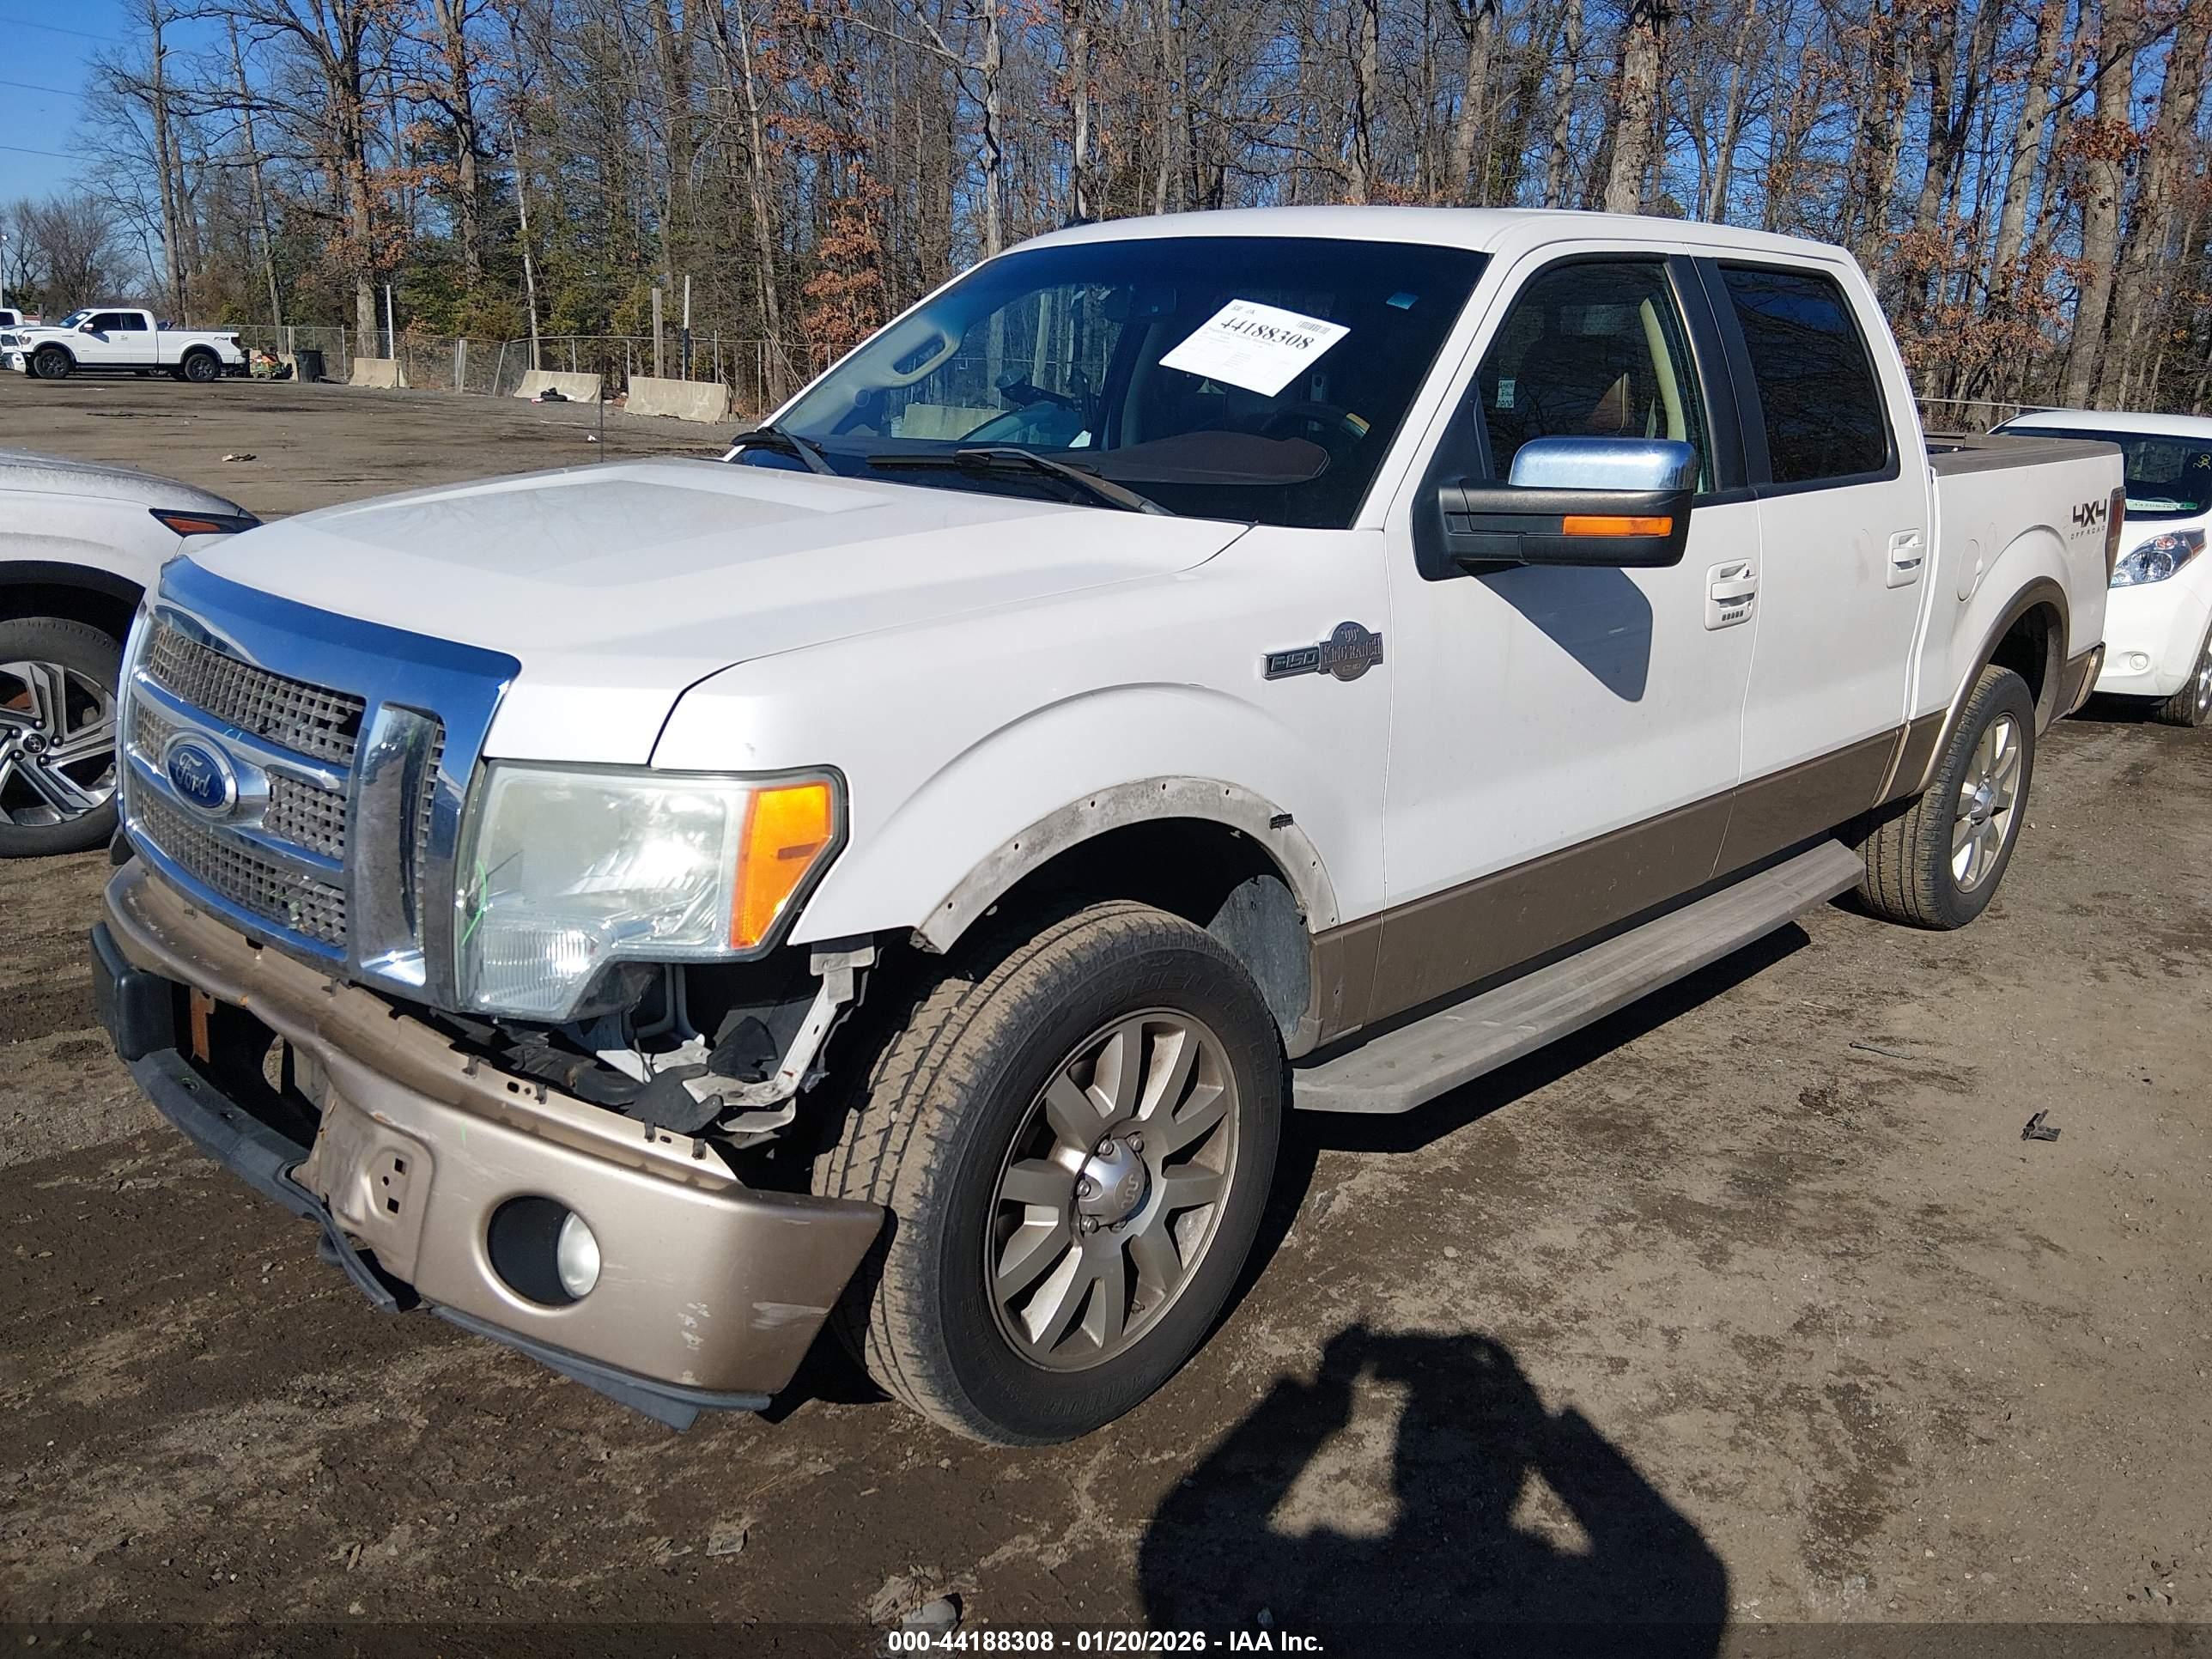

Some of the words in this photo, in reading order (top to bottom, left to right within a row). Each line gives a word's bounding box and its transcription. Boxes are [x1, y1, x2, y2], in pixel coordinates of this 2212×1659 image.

[1220, 317, 1315, 350] 44188308
[2072, 498, 2107, 528] 4X4
[176, 752, 211, 798] Ford
